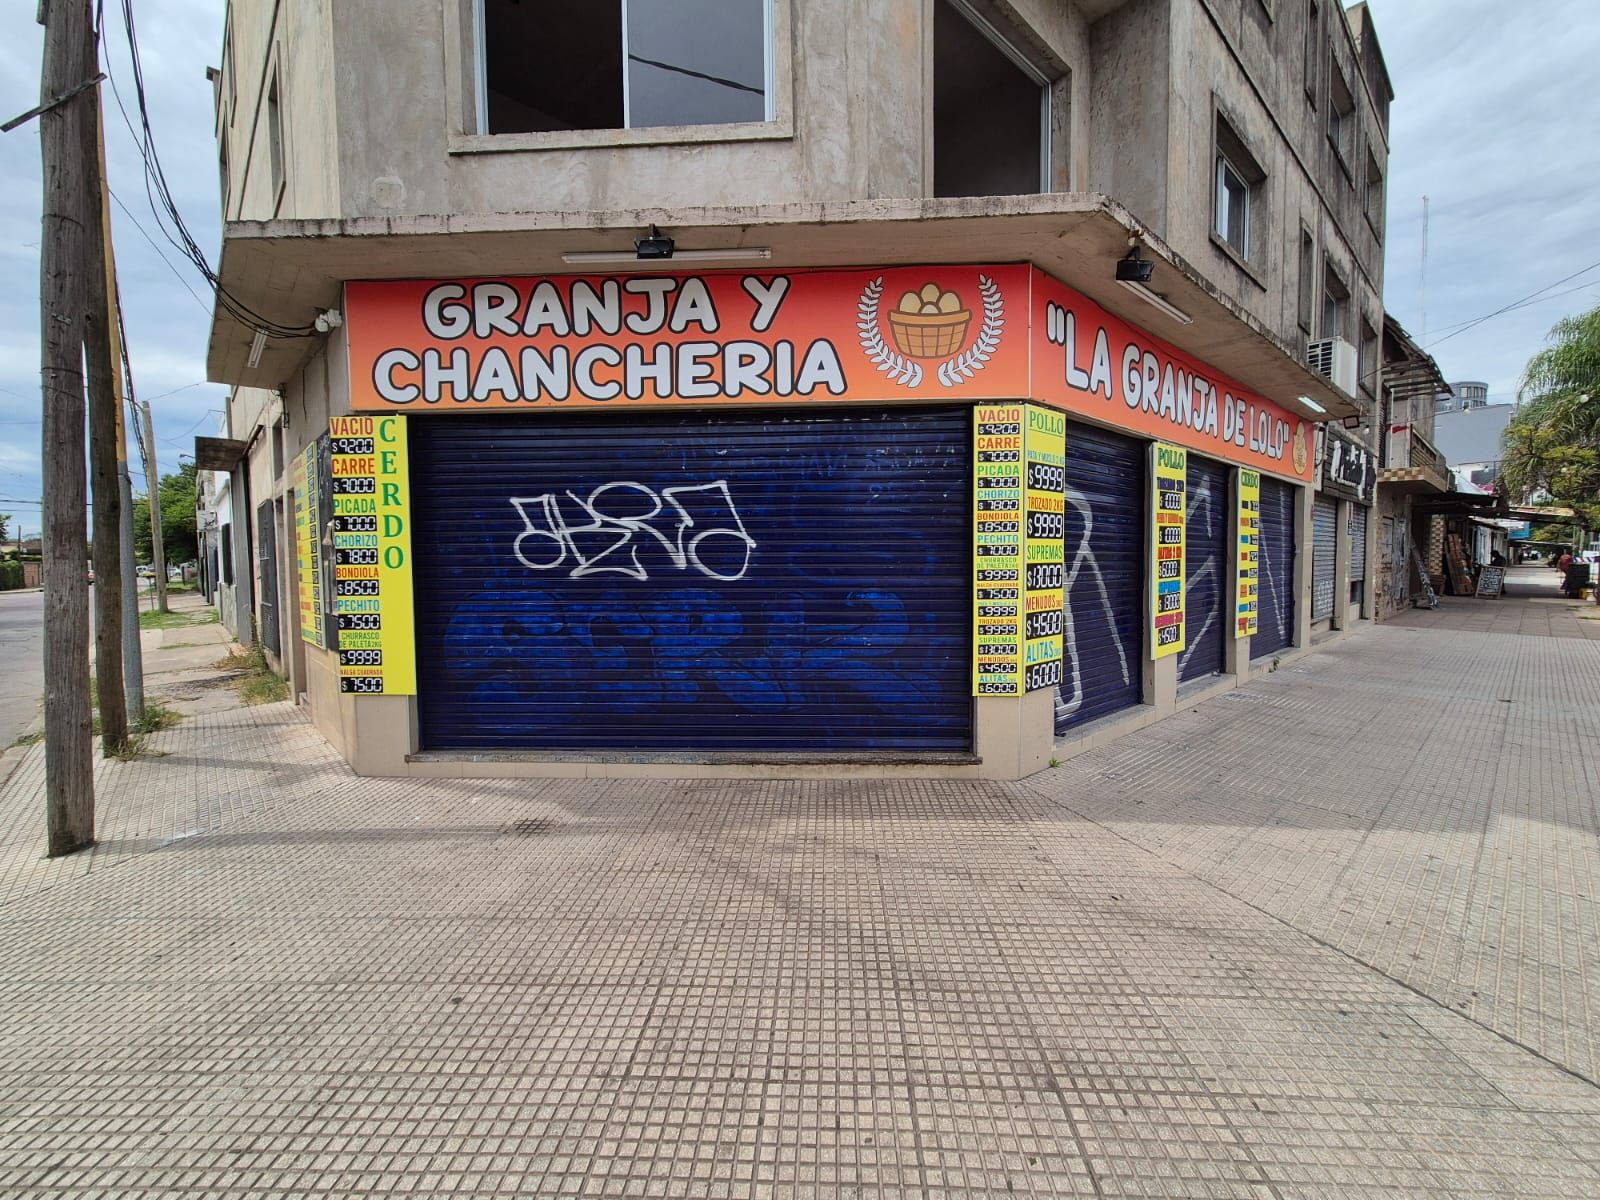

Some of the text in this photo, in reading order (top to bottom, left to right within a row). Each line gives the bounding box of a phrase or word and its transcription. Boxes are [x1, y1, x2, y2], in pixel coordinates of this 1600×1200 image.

[422, 275, 791, 340] GRANJA Y
[372, 338, 847, 404] CHANCHERIA
[1122, 343, 1219, 439] GRANJA
[1223, 392, 1247, 447] DE
[978, 409, 1020, 422] VACIO
[1029, 411, 1064, 434] POLLO
[331, 417, 374, 436] VACIO
[978, 437, 1020, 449] CARRE
[331, 458, 375, 475] CARRE
[1157, 449, 1185, 470] POLLO
[977, 465, 1019, 476] PICADA
[379, 418, 404, 569] CERDO
[977, 489, 1019, 500] CHORIZO
[333, 498, 376, 514] PICADA
[1028, 496, 1052, 511] TROZADO
[977, 512, 1019, 520] BONDIOLA
[335, 534, 378, 547] CHORIZO
[977, 535, 1019, 544] PECHITO
[1027, 545, 1063, 560] SUPREMAS
[336, 567, 379, 578] BONDIOLA
[336, 600, 380, 612] PECHITO
[1026, 594, 1056, 610] MENUDOS
[341, 632, 380, 640] CHURRASCO
[1026, 641, 1054, 663] ALITAS
[979, 674, 1008, 682] ALITAS
